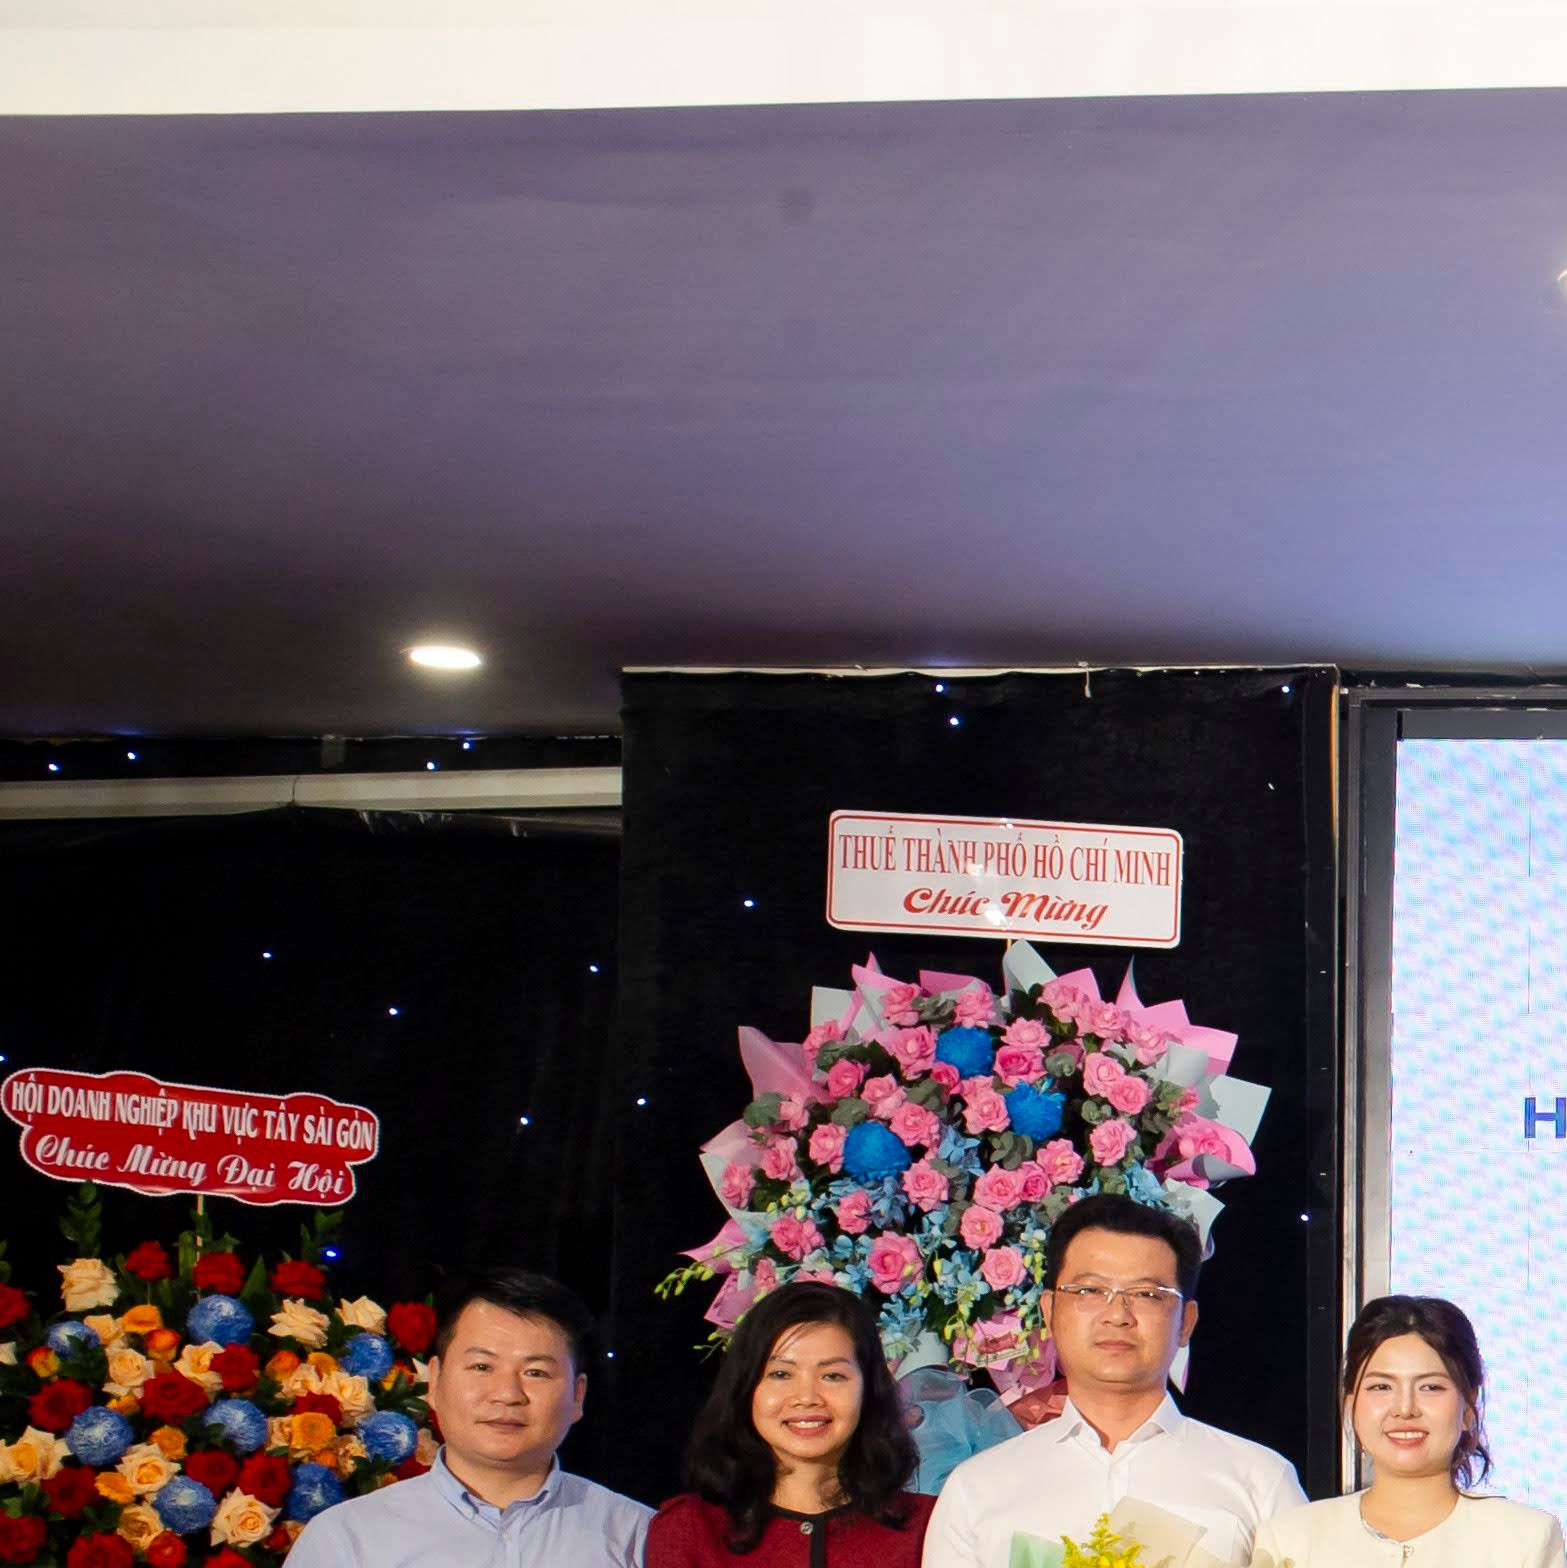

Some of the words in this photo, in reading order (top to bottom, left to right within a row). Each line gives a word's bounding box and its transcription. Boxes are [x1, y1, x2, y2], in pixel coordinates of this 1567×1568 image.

[838, 824, 896, 871] THUẾ
[903, 827, 979, 877] THÀNH
[983, 832, 1027, 878] PHỐ
[1032, 834, 1064, 880] HỒ
[1069, 837, 1110, 883] CHÍ
[1113, 848, 1172, 887] MINH
[903, 887, 990, 915] Chúc
[1001, 890, 1110, 930] Mừng
[12, 1073, 43, 1122] HỘI
[47, 1085, 111, 1121] DOANH
[115, 1088, 178, 1136] NGHIỆP
[182, 1100, 217, 1141] KHU
[222, 1102, 258, 1145] VỰC
[263, 1101, 300, 1142] TÂY
[303, 1106, 332, 1146] SÀI
[336, 1110, 373, 1150] GÒN
[35, 1134, 110, 1170] Chúc
[116, 1143, 207, 1187] Mừng
[217, 1154, 276, 1192] Đại
[288, 1160, 345, 1199] Hội
